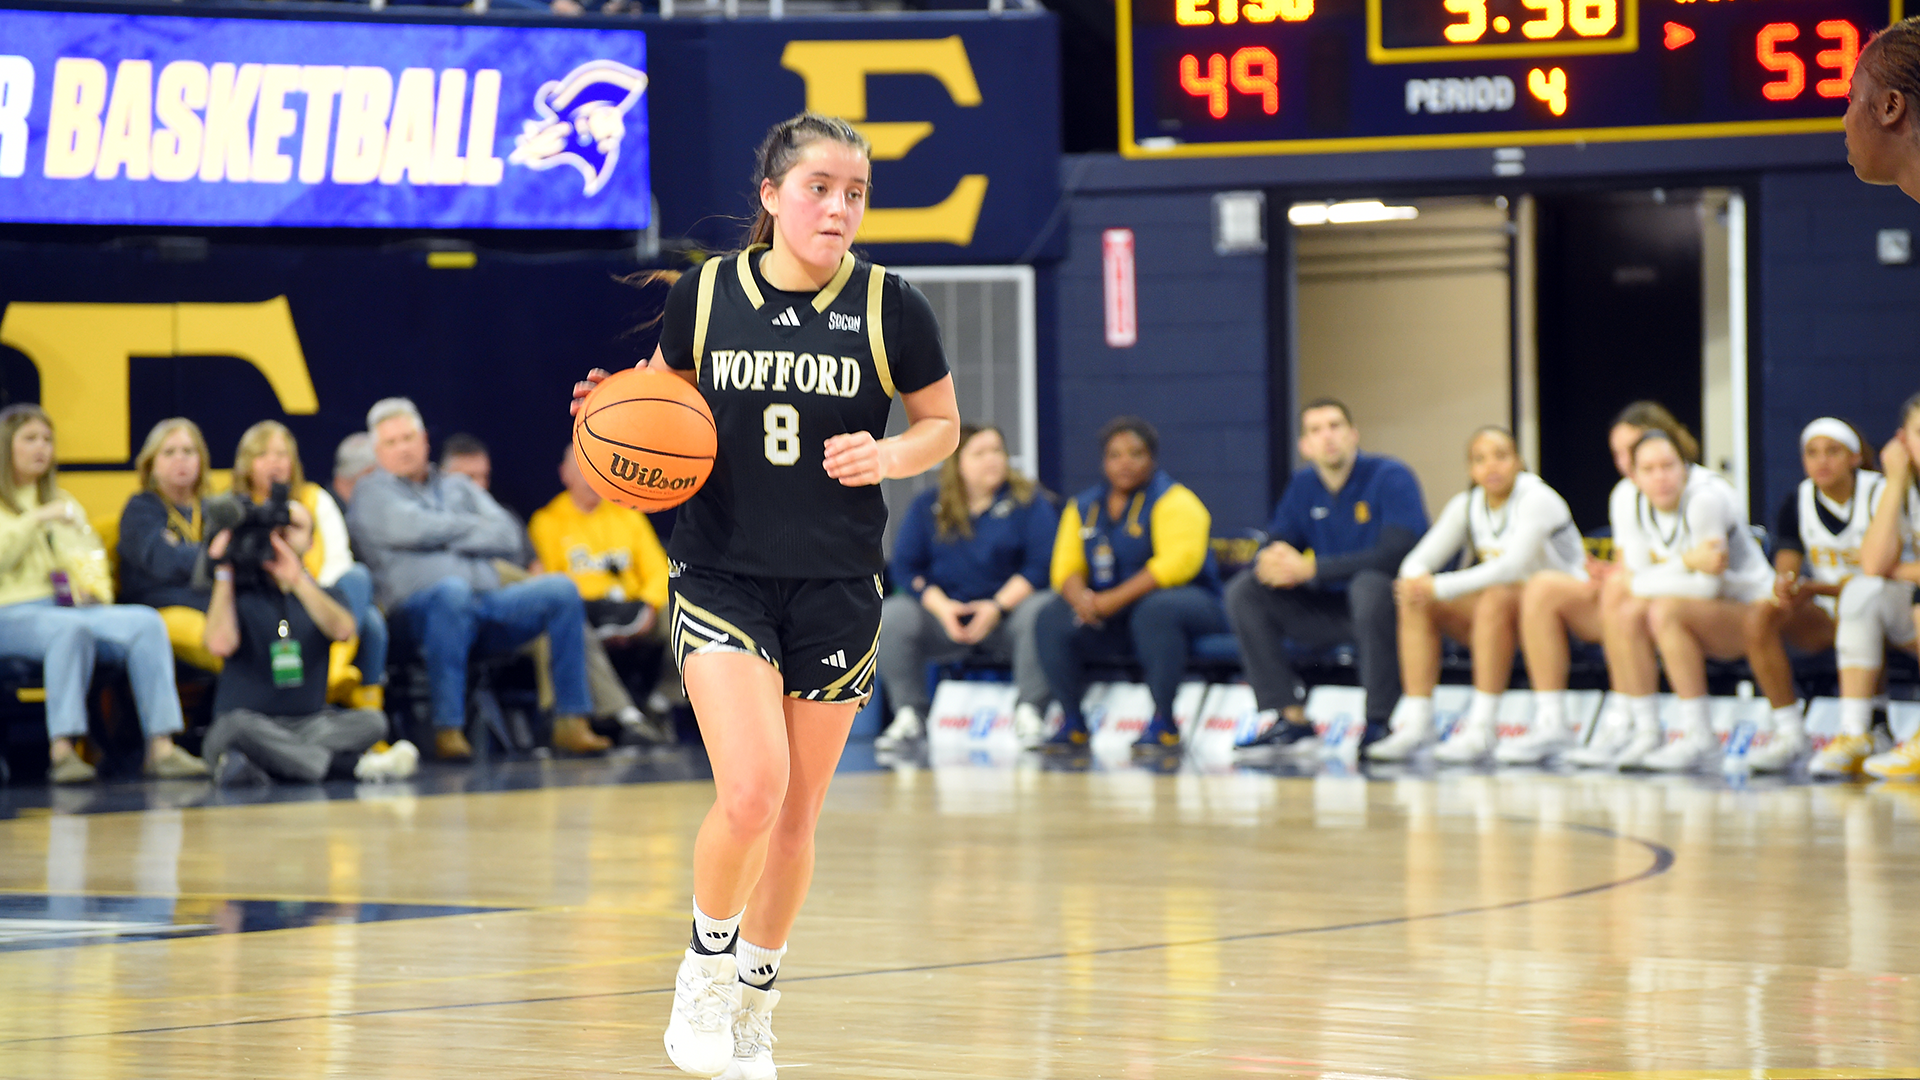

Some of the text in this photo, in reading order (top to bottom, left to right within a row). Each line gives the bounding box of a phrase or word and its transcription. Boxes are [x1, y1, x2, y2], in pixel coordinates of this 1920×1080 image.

[1180, 46, 1279, 119] 49
[1404, 67, 1567, 116] PERIOD 4
[1756, 19, 1859, 101] 53
[43, 57, 503, 186] BASKETBALL
[780, 34, 989, 247] E
[828, 310, 861, 333] SOCON
[710, 350, 861, 398] WOFFORD
[762, 403, 801, 466] 8
[610, 452, 697, 490] Wilson
